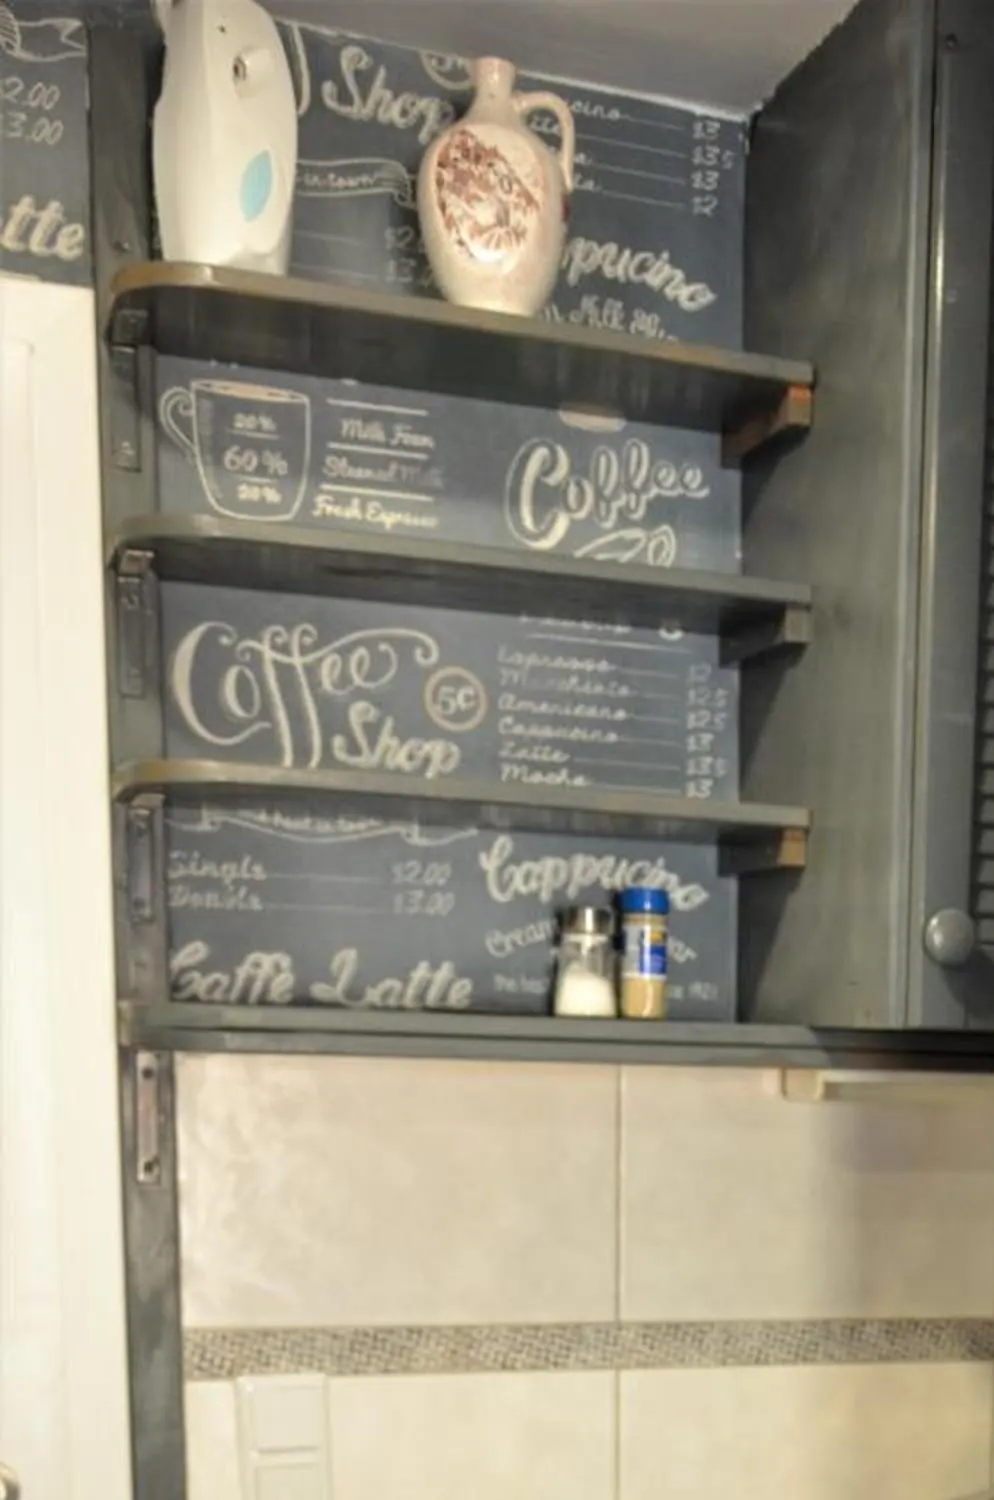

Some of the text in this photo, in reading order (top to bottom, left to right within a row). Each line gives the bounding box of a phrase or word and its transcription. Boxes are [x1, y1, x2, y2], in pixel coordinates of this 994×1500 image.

[320, 44, 456, 145] Shop
[0, 194, 84, 260] tte
[562, 236, 719, 313] pucino
[172, 620, 440, 769] Coffee
[333, 702, 462, 779] Shop
[308, 946, 474, 1007] Latte
